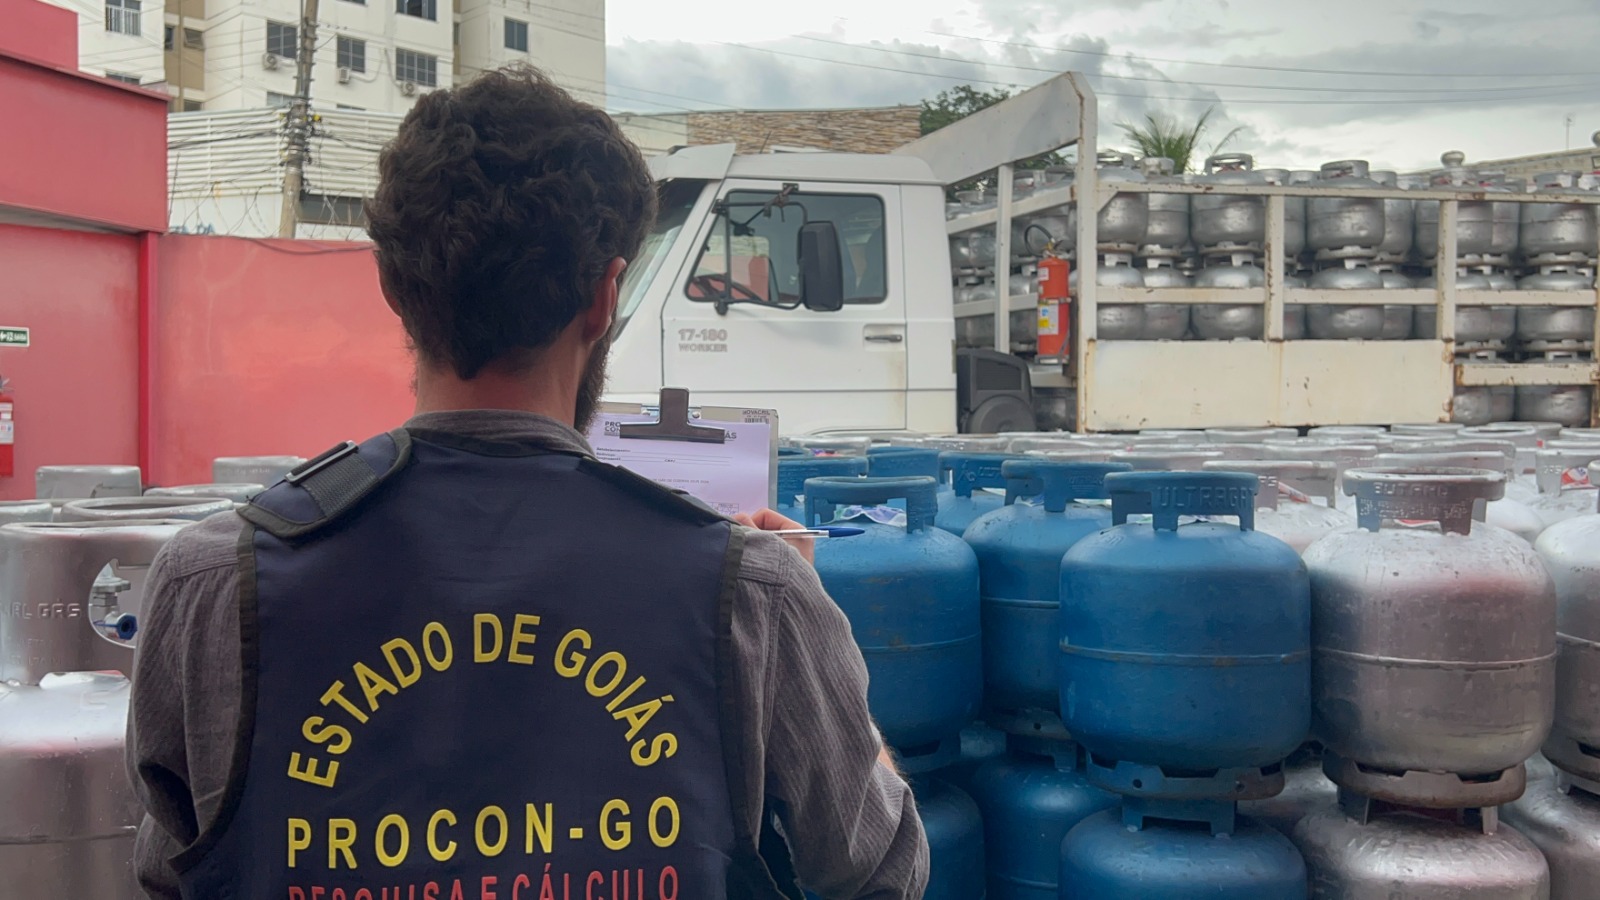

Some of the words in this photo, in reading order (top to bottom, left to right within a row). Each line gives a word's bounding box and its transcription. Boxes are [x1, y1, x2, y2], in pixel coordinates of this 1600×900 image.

[678, 328, 728, 341] 17-180
[679, 343, 728, 352] WORKER
[288, 622, 454, 788] ESTADO
[474, 613, 541, 665] DE
[554, 628, 680, 768] GOIÁS
